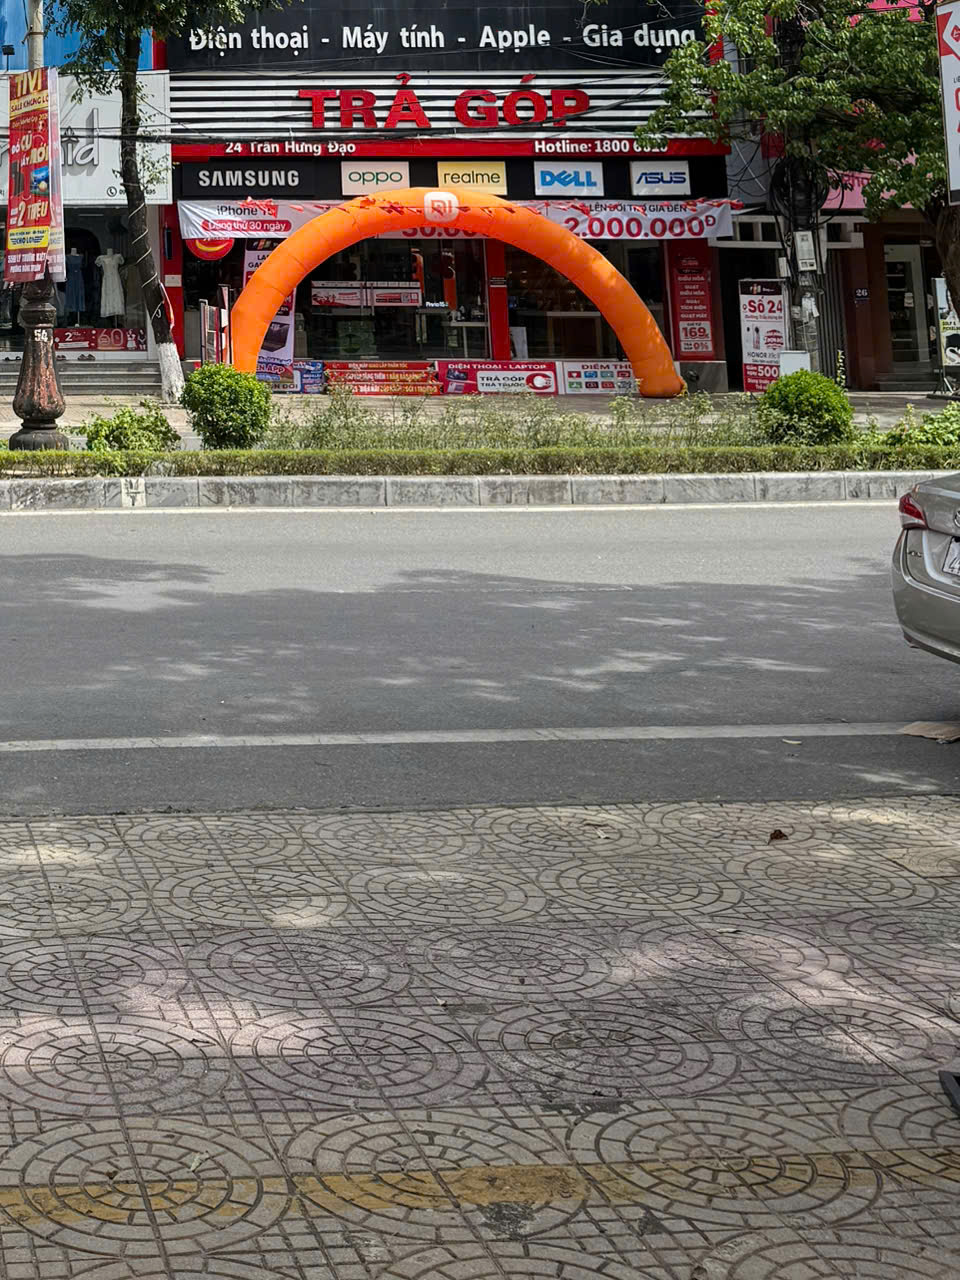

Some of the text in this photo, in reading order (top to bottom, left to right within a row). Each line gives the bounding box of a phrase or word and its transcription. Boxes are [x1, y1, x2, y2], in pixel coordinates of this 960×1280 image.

[189, 25, 242, 57] Điện
[251, 24, 309, 56] thoại
[342, 23, 389, 54] Máy
[400, 24, 445, 48] tính
[479, 23, 551, 53] Apple
[582, 23, 623, 48] Gia
[634, 23, 696, 54] dụng
[15, 68, 42, 98] TIVI
[298, 72, 590, 129] TRẢ GÓP
[225, 141, 242, 153] 24
[284, 140, 322, 156] Hưng
[327, 140, 356, 157] Đạo
[534, 139, 592, 153] Hotline:
[594, 140, 630, 153] 1800
[198, 170, 300, 187] SAMSUNG
[348, 170, 403, 185] oppo
[443, 170, 501, 184] realme
[540, 170, 597, 187] DELL
[635, 171, 687, 185] ASUS
[217, 205, 258, 216] iPhone
[589, 202, 608, 212] LÊN
[250, 221, 261, 230] 30
[263, 221, 286, 231] ngày
[855, 288, 868, 297] 26
[747, 295, 783, 313] Số 24
